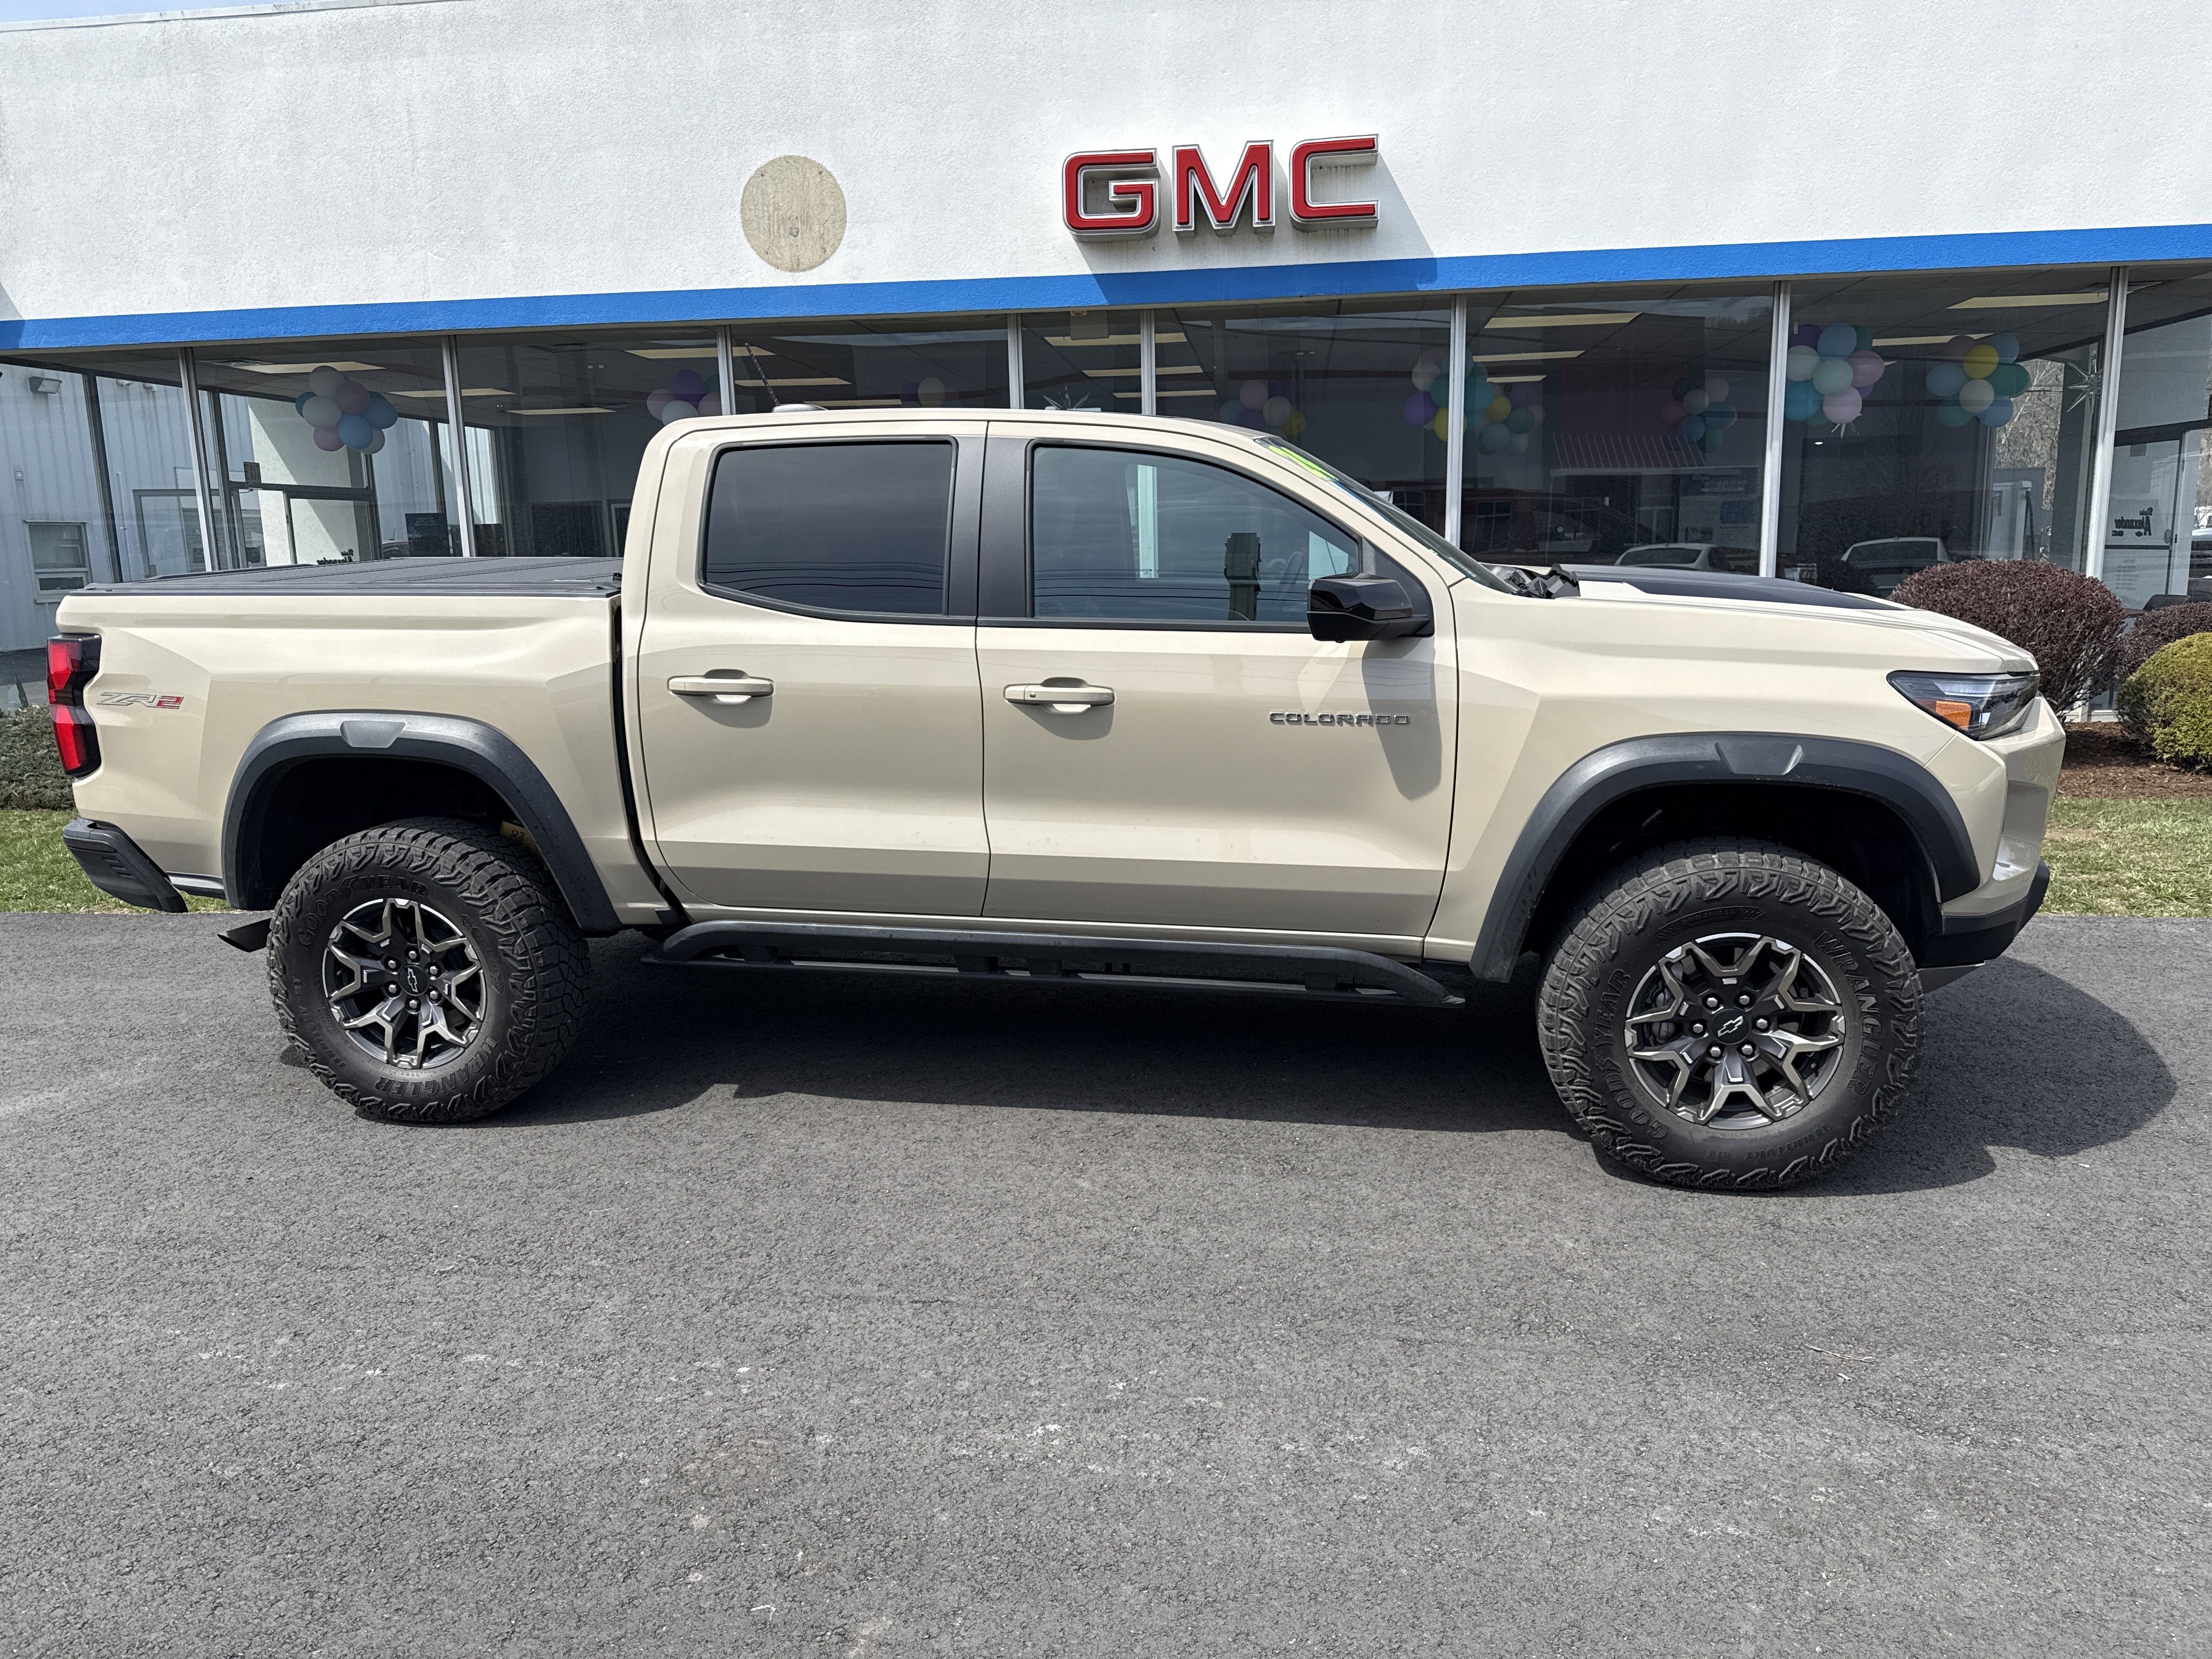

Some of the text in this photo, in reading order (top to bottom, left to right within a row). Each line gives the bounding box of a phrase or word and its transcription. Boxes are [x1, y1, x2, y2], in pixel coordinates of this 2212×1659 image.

[1062, 133, 1379, 234] GMC
[97, 692, 184, 709] ZR2
[1269, 711, 1409, 724] COLORADO
[298, 874, 429, 945] GOODYEAR
[1813, 930, 1882, 1096] WRANGLER
[375, 1035, 498, 1097] WRANGLER
[1592, 969, 1668, 1138] GOODYEAR
